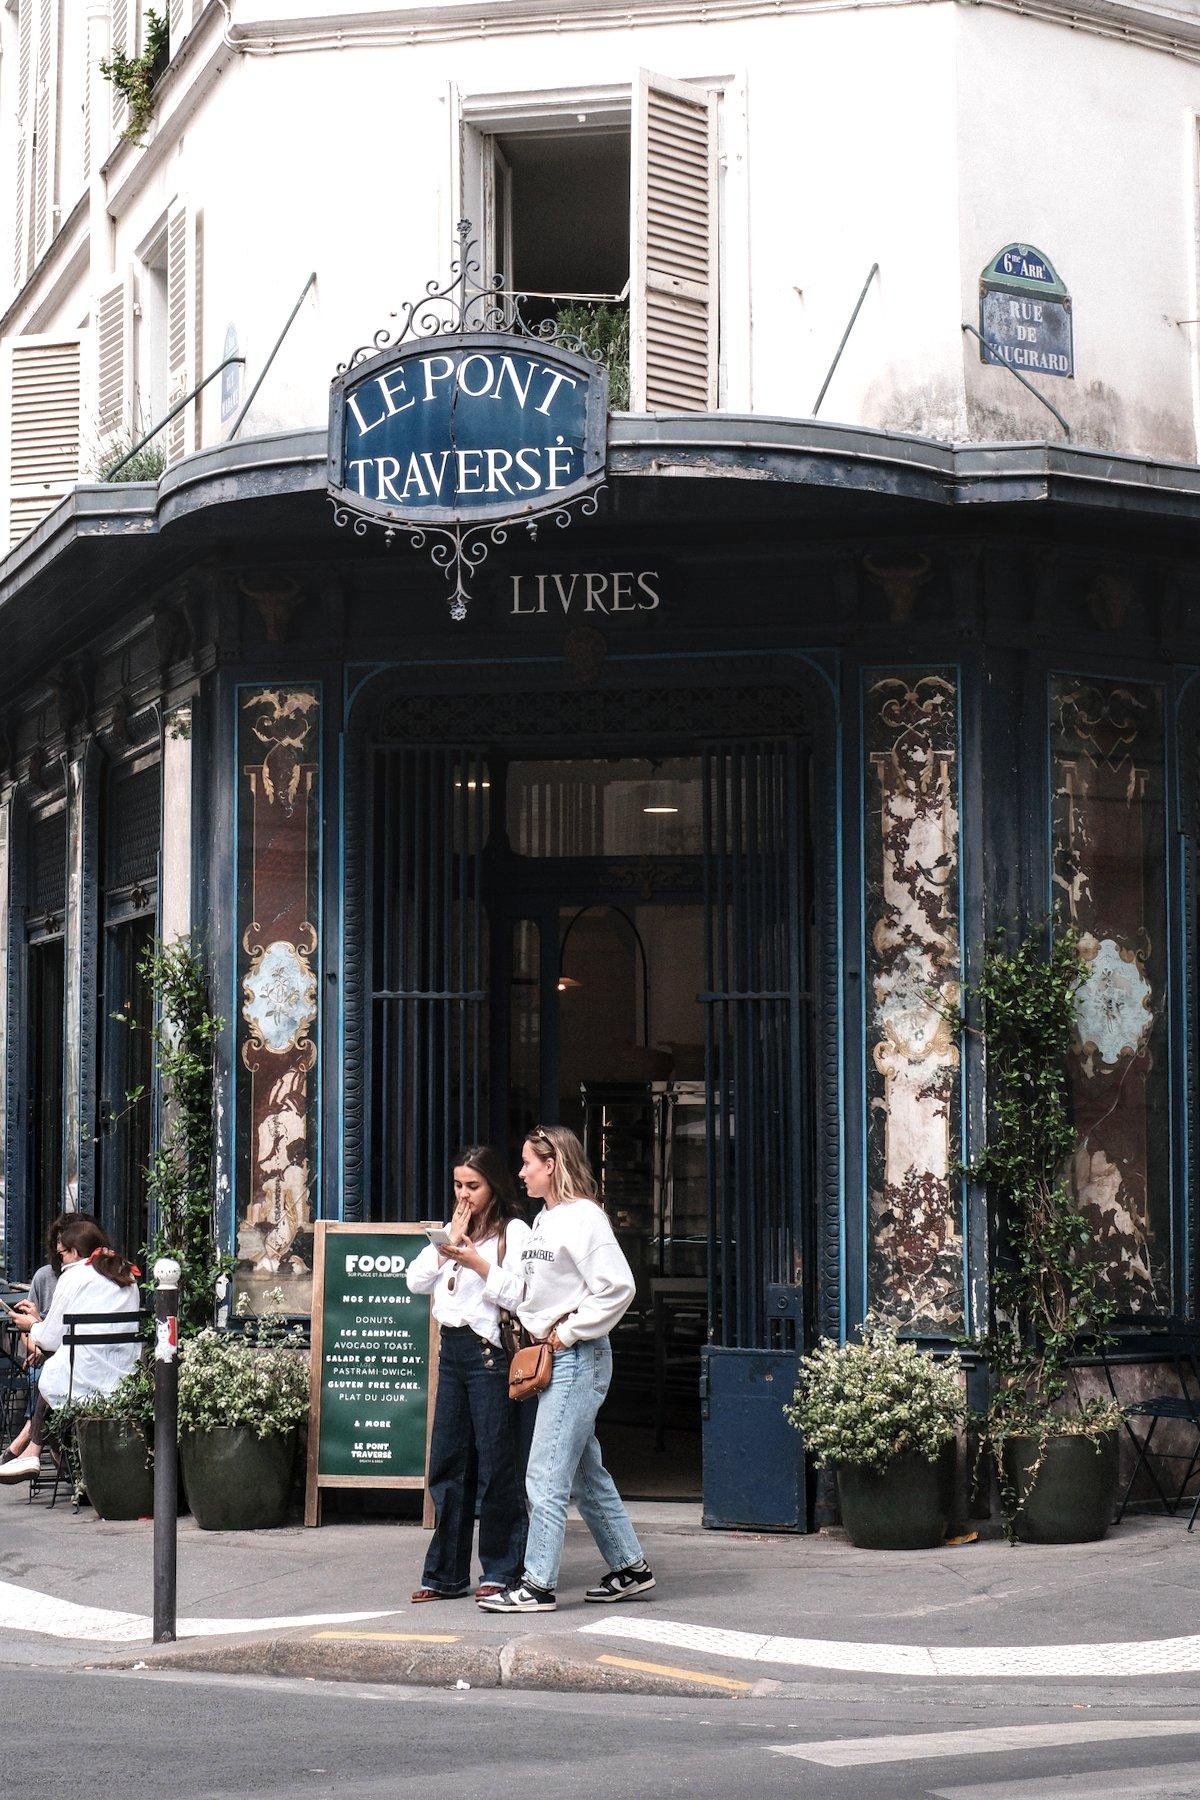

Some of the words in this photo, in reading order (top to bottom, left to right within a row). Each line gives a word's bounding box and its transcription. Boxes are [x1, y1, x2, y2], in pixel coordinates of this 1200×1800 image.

[1009, 300, 1043, 322] RUE
[1016, 325, 1037, 343] DE
[345, 366, 416, 437] LE
[419, 354, 577, 417] PONT
[348, 435, 575, 503] TRAVERSÉ
[509, 571, 661, 616] LIVRES
[342, 1295, 363, 1303] NOS
[369, 1296, 411, 1304] FAVORIS
[356, 1316, 396, 1324] DONUTS.
[340, 1329, 358, 1337] EGG
[333, 1342, 381, 1350] AVOCADO
[383, 1342, 417, 1351] TOAST.
[325, 1355, 361, 1363] SALADE
[364, 1356, 377, 1364] OF
[380, 1356, 398, 1364] THE
[402, 1356, 424, 1364] DAY.
[333, 1367, 379, 1376] PASTRAMI
[327, 1381, 364, 1389] GLUTEN
[368, 1381, 390, 1389] FREE
[394, 1381, 421, 1390] CAKE.
[339, 1393, 362, 1401] PLAT
[364, 1393, 378, 1402] DU
[380, 1394, 408, 1402] JOUR.
[353, 1420, 361, 1428] &
[364, 1420, 392, 1428] MORE
[350, 1450, 393, 1459] TRAVERSÉ
